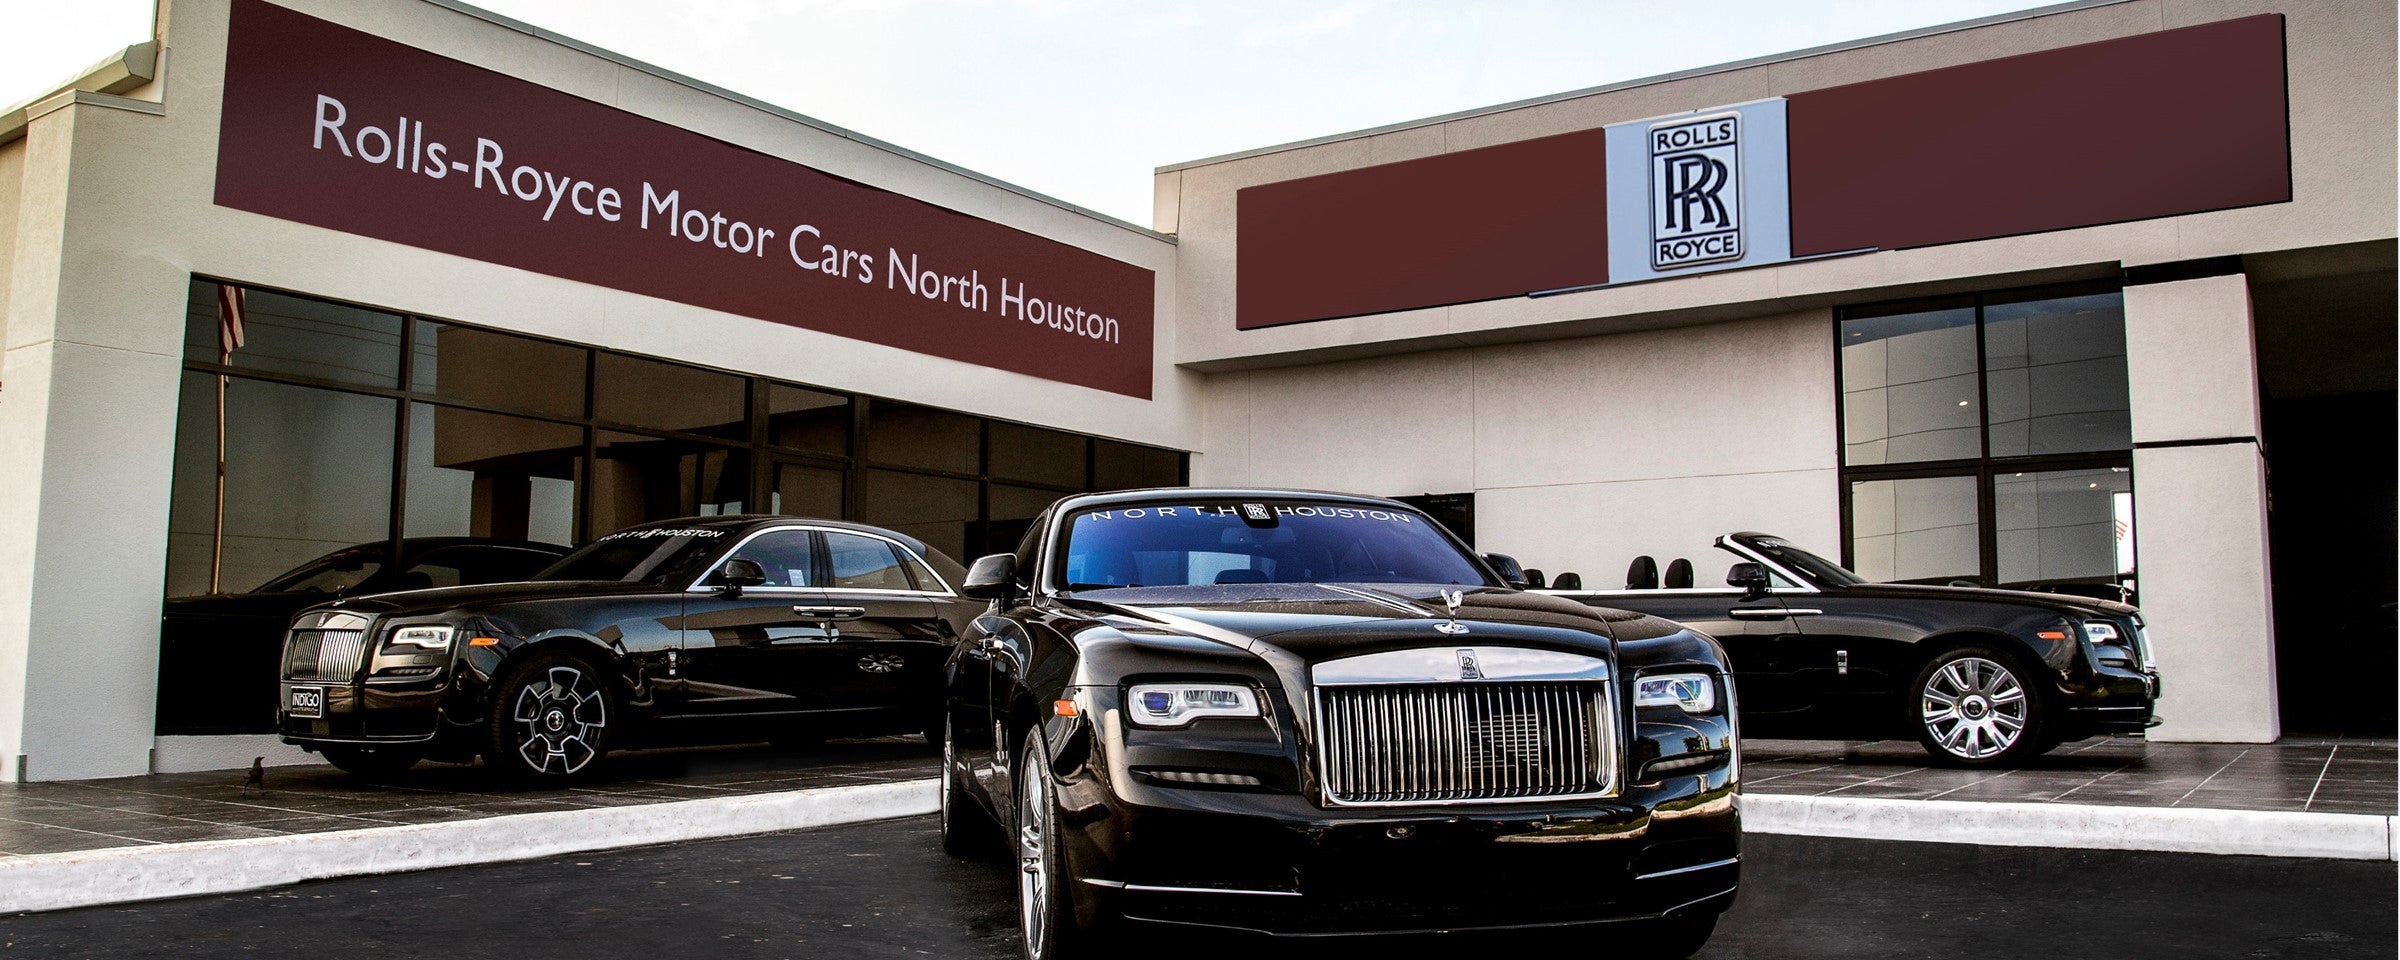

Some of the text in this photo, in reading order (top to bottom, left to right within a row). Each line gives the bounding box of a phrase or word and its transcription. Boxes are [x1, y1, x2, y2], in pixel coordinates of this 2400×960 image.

[1656, 122, 1731, 151] ROLLS
[312, 93, 1120, 345] Rolls-Royce Motor Cars North Houston
[1659, 234, 1734, 262] ROYCE
[1091, 505, 1238, 521] NORTH
[1273, 505, 1411, 523] HOUSTON
[655, 529, 724, 538] HOUSTON
[292, 692, 319, 707] INDIGO
